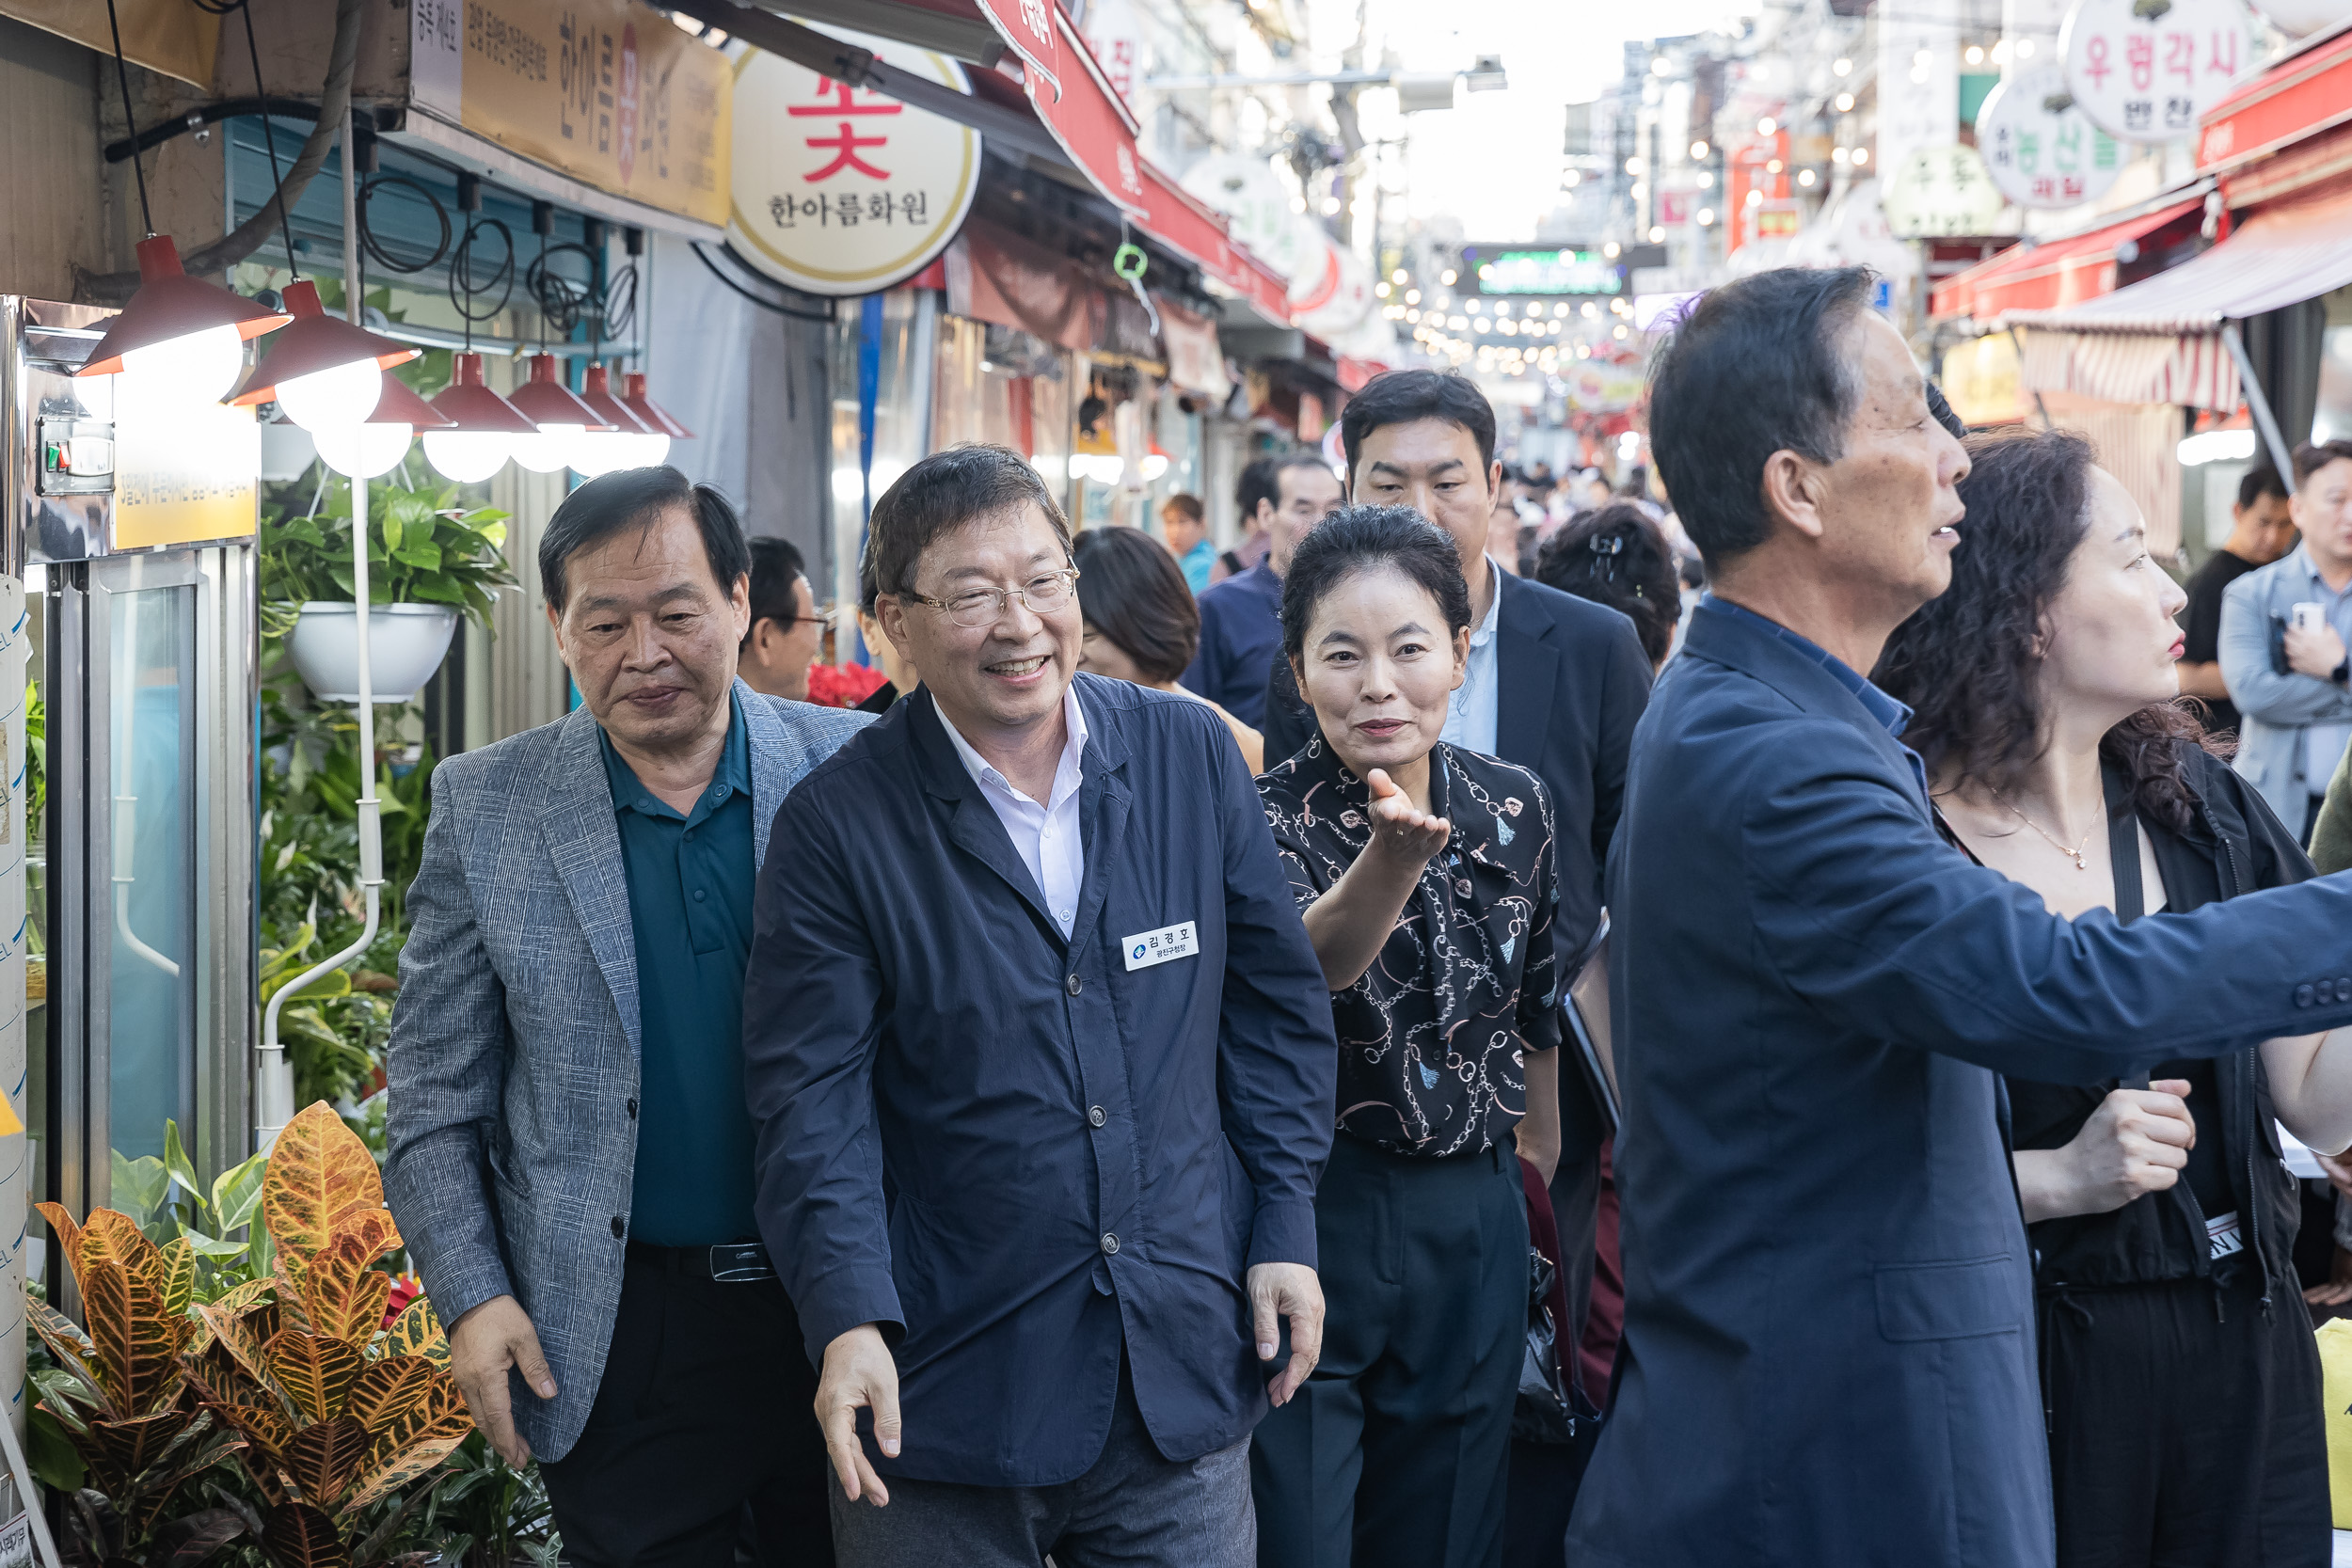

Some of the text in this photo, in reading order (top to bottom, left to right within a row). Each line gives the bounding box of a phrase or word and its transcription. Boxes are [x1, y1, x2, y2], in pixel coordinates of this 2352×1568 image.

[2084, 31, 2238, 91] 우렁각시
[787, 55, 903, 183] 꽃
[2123, 97, 2192, 130] 반찬
[2014, 121, 2117, 175] 농산물
[768, 189, 929, 230] 한아름화원
[1149, 928, 1190, 949] 김경호
[1156, 943, 1186, 958] 광진구청장
